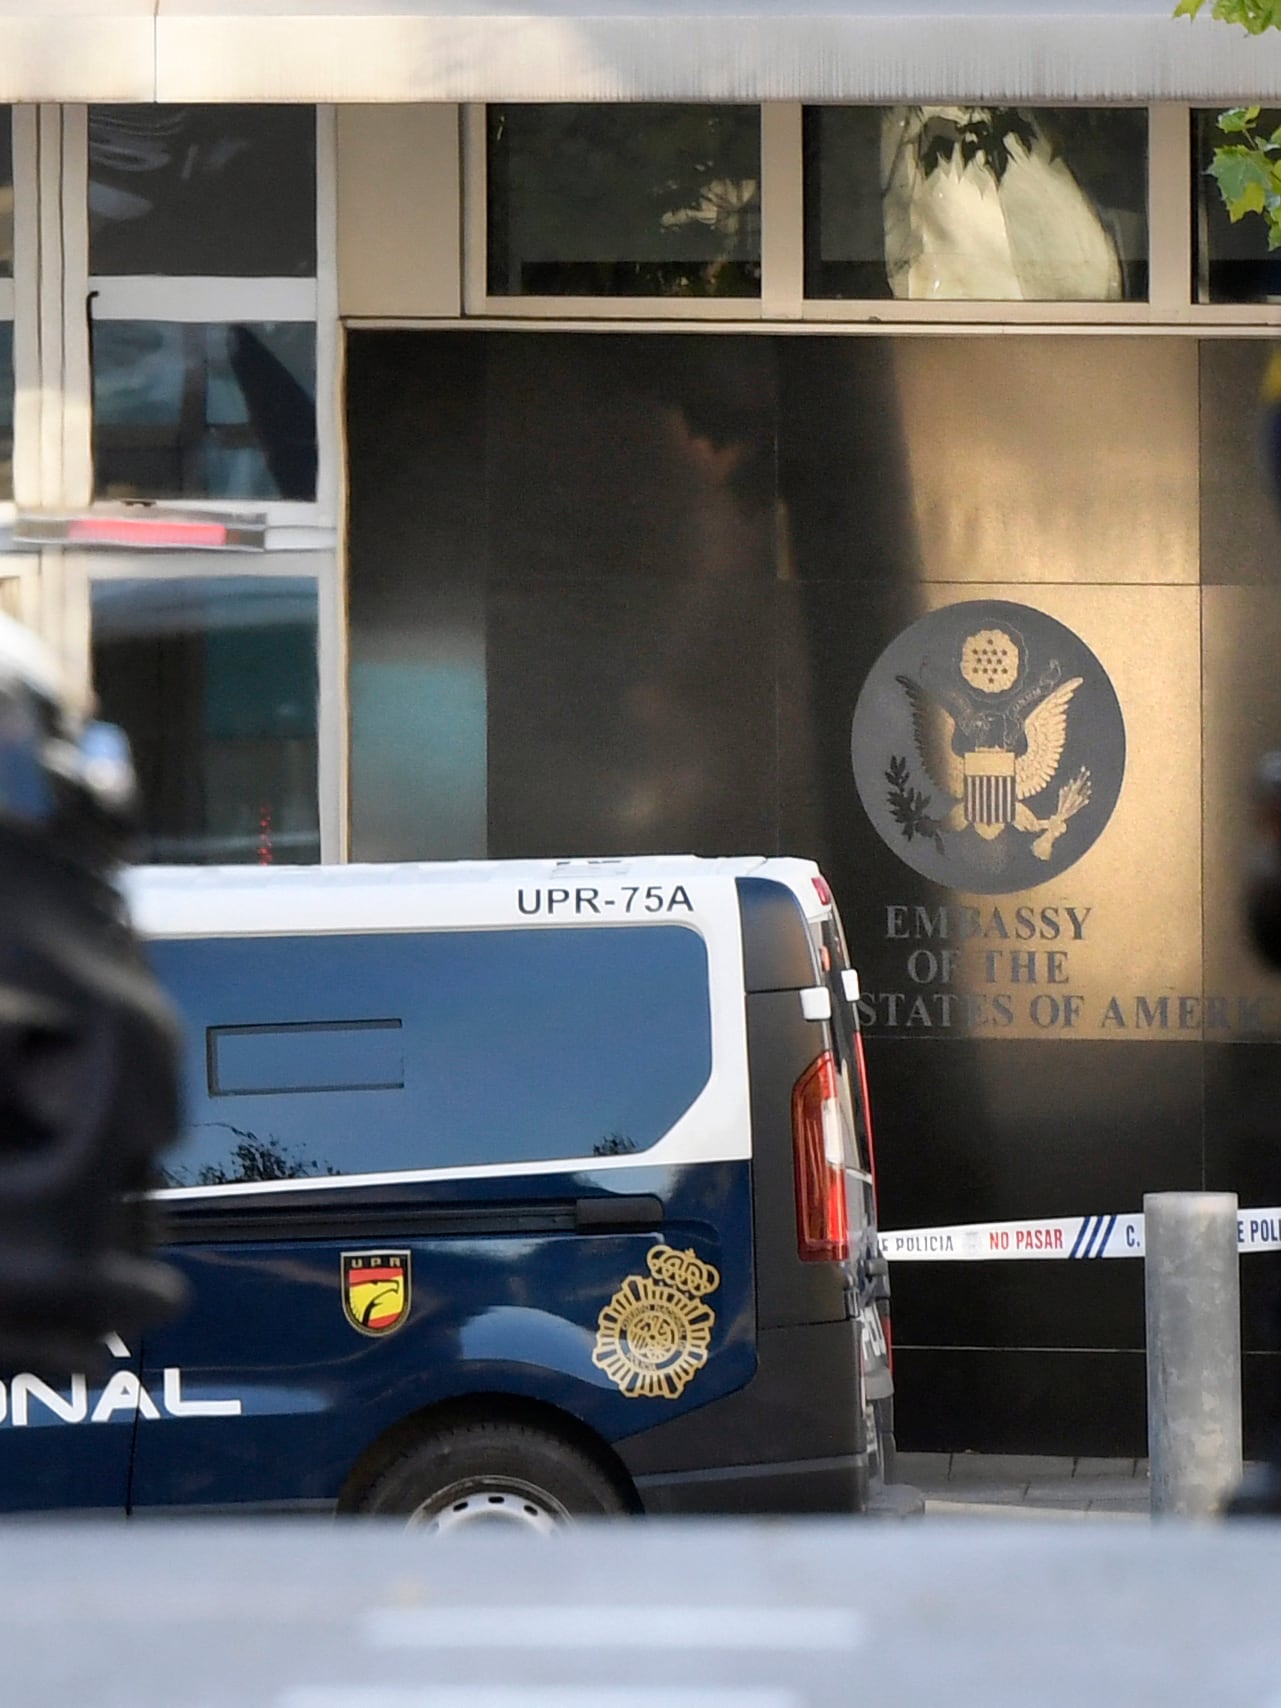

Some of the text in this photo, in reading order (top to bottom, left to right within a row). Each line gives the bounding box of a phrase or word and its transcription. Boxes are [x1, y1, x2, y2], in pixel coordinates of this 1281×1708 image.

[517, 885, 695, 915] UPR-75A
[884, 904, 1092, 941] EMBASSY
[906, 949, 1070, 985] OF THE
[859, 993, 1014, 1029] STATES
[1029, 994, 1086, 1029] OF
[896, 1235, 954, 1251] POLICIA
[989, 1232, 1010, 1251] NO
[1015, 1229, 1064, 1250] PASAR
[1125, 1223, 1141, 1247] C.
[350, 1256, 402, 1269] UPR
[0, 1366, 242, 1427] NAL
